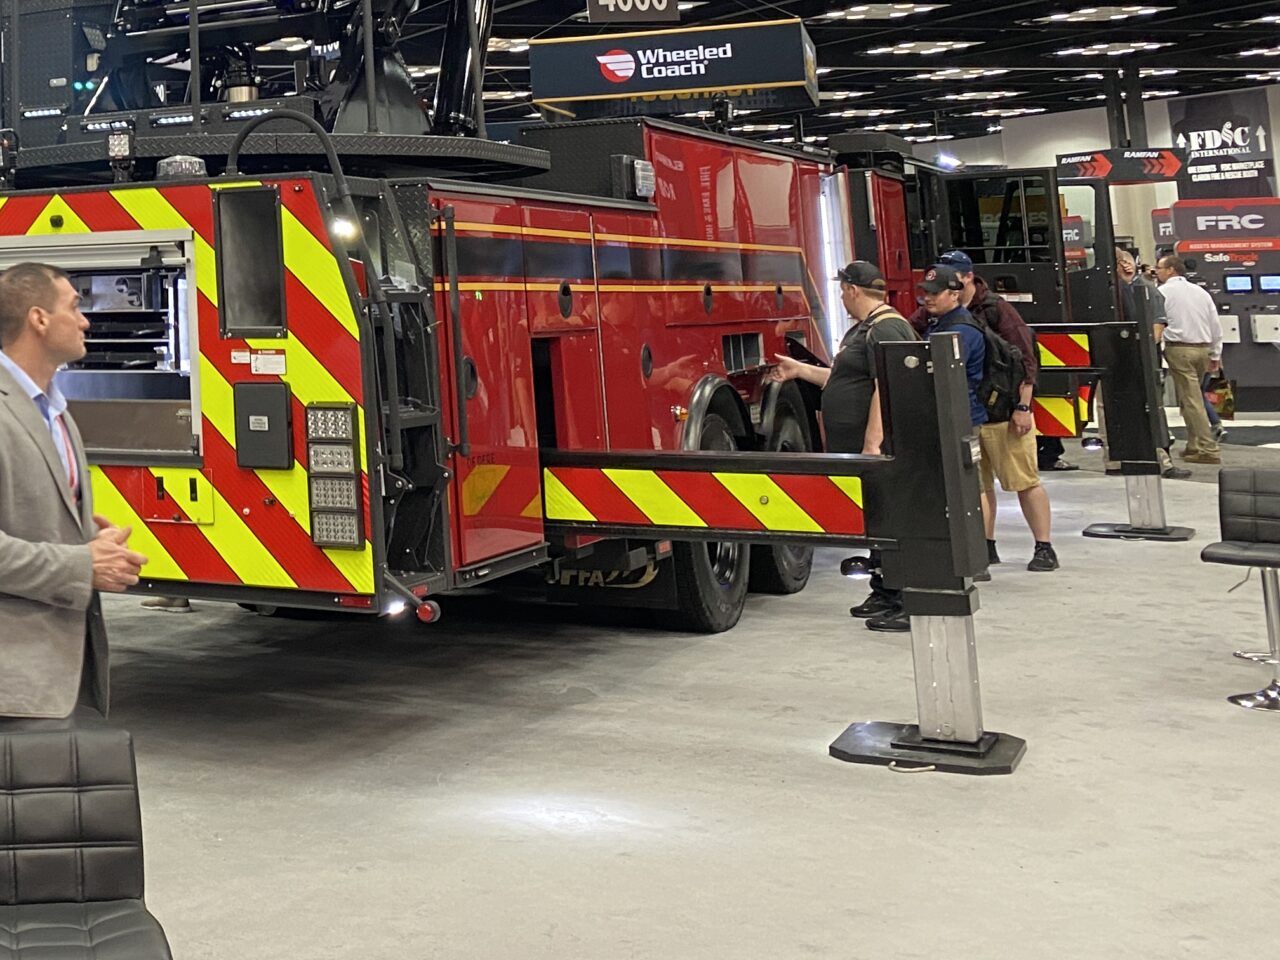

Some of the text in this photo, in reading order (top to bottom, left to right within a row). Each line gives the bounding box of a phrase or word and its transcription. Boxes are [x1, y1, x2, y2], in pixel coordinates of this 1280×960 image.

[637, 43, 732, 64] Wheeled
[1191, 147, 1251, 158] INTERNATIONAL
[1196, 214, 1265, 230] FRC
